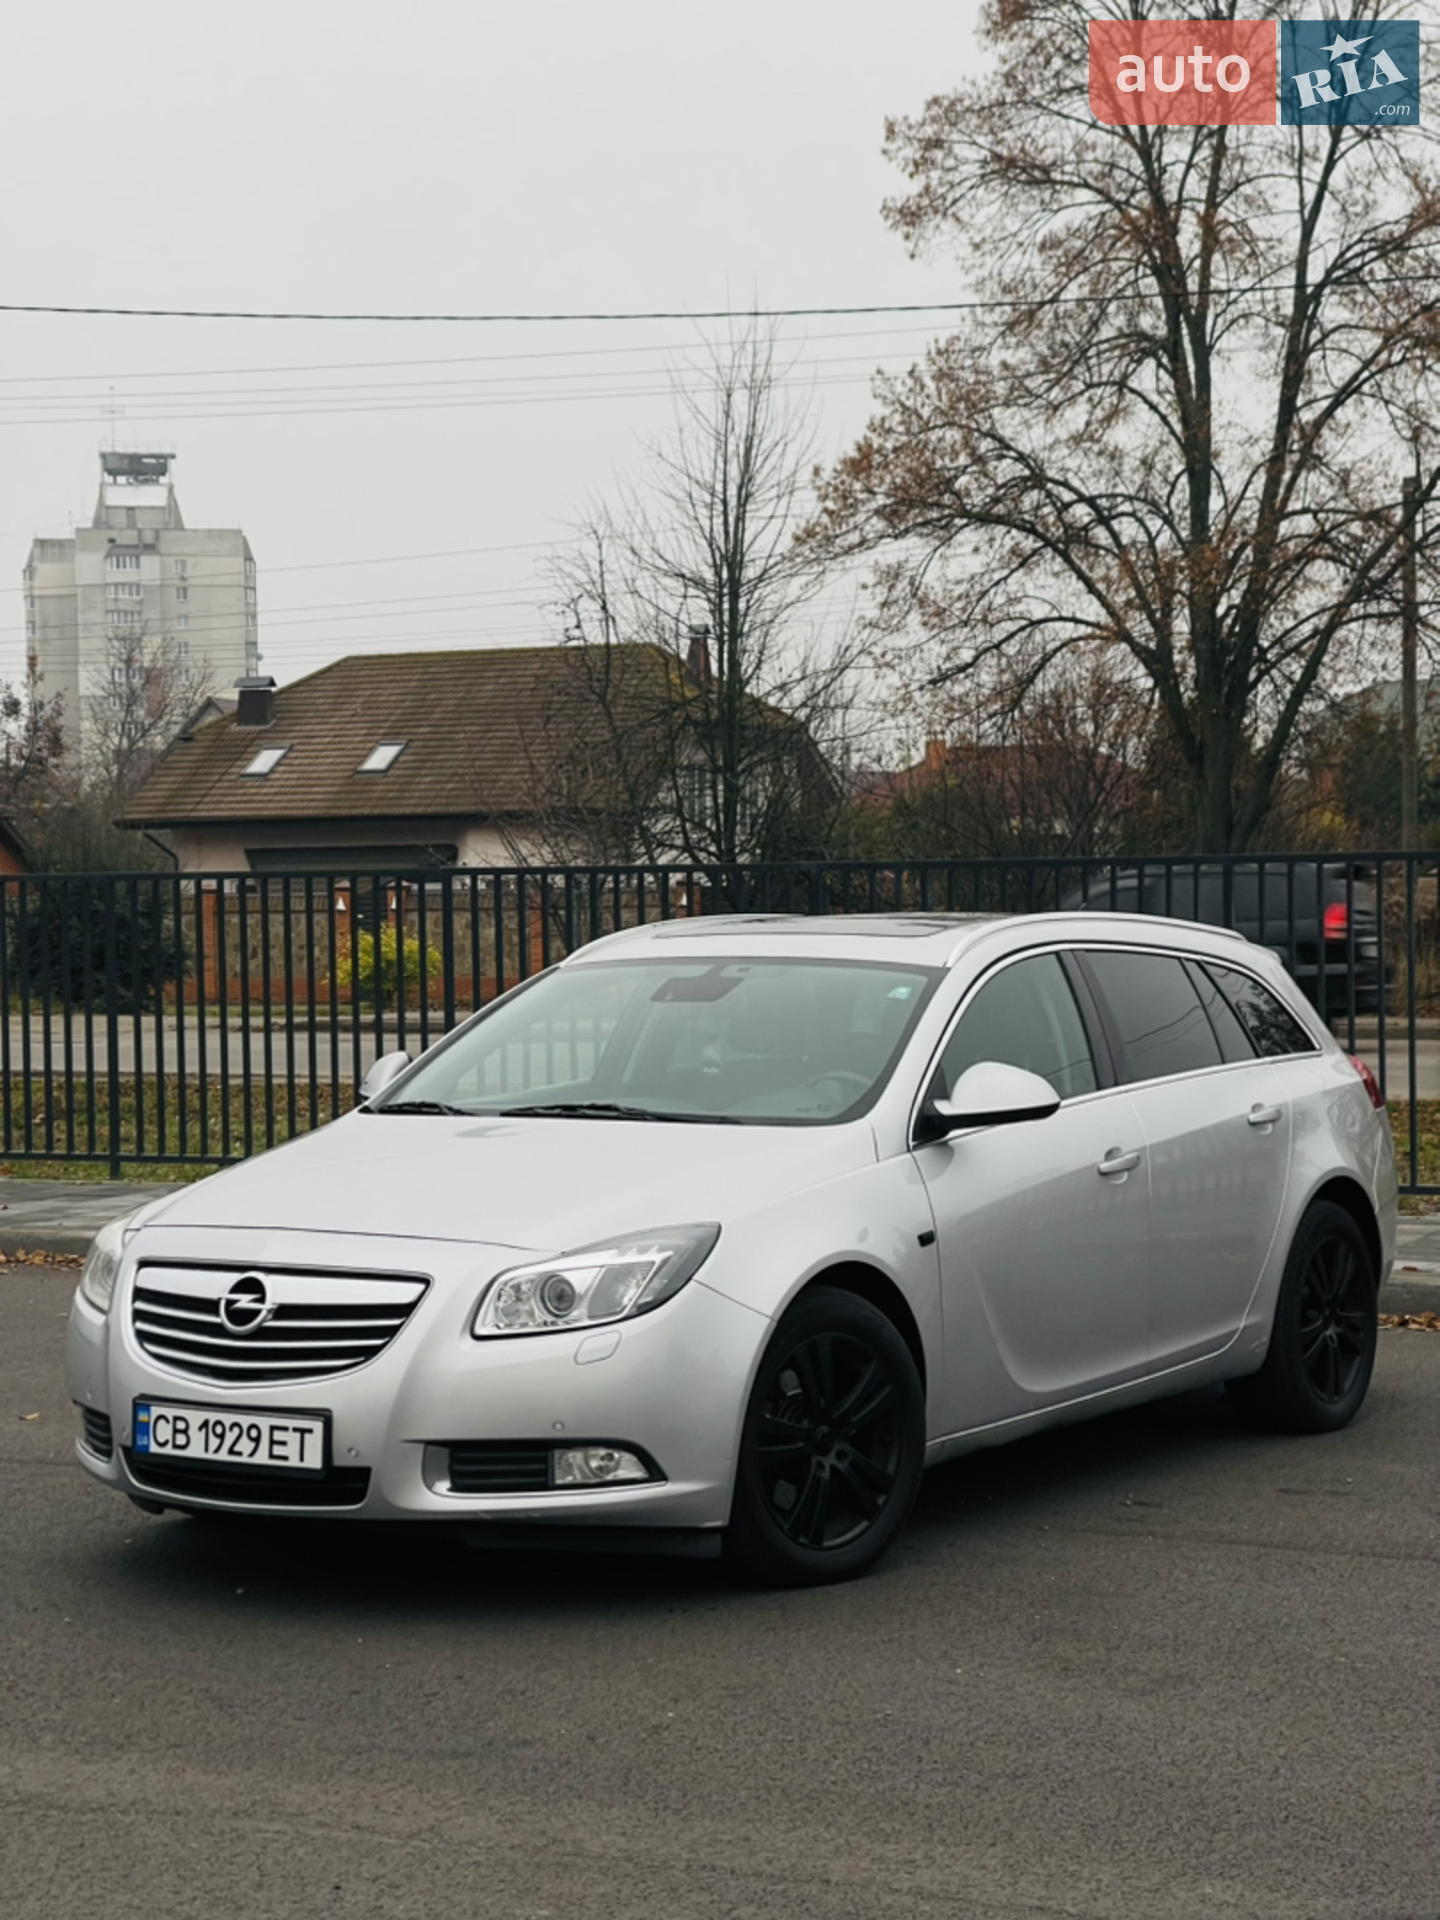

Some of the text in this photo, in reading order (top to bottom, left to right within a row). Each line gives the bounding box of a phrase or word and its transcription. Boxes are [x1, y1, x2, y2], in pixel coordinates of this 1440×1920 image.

[152, 1414, 314, 1463] CB 1929 ET
